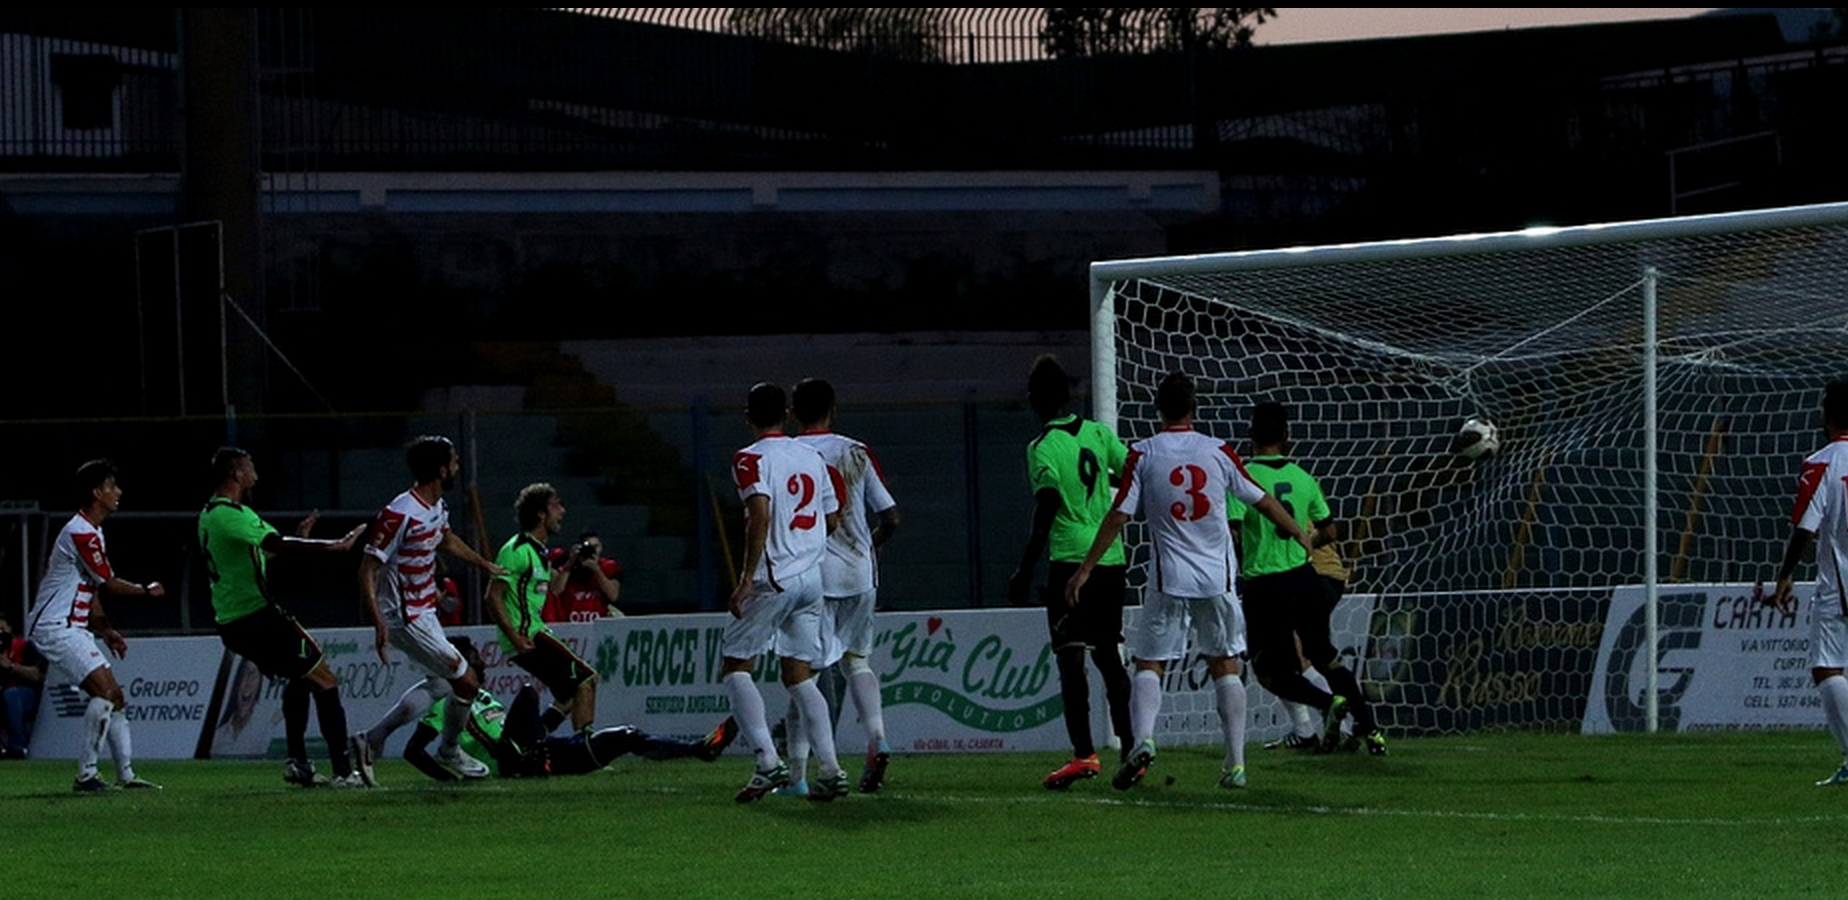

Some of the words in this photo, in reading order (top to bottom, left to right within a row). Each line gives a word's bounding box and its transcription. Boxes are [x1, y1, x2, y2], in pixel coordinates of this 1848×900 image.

[1079, 448, 1098, 499] 9
[1170, 465, 1210, 521] 3
[788, 474, 817, 531] 2
[624, 628, 698, 686] CROCE
[963, 634, 1050, 699] Club
[124, 703, 204, 721] ENTRONE
[130, 677, 200, 697] GRUPPO
